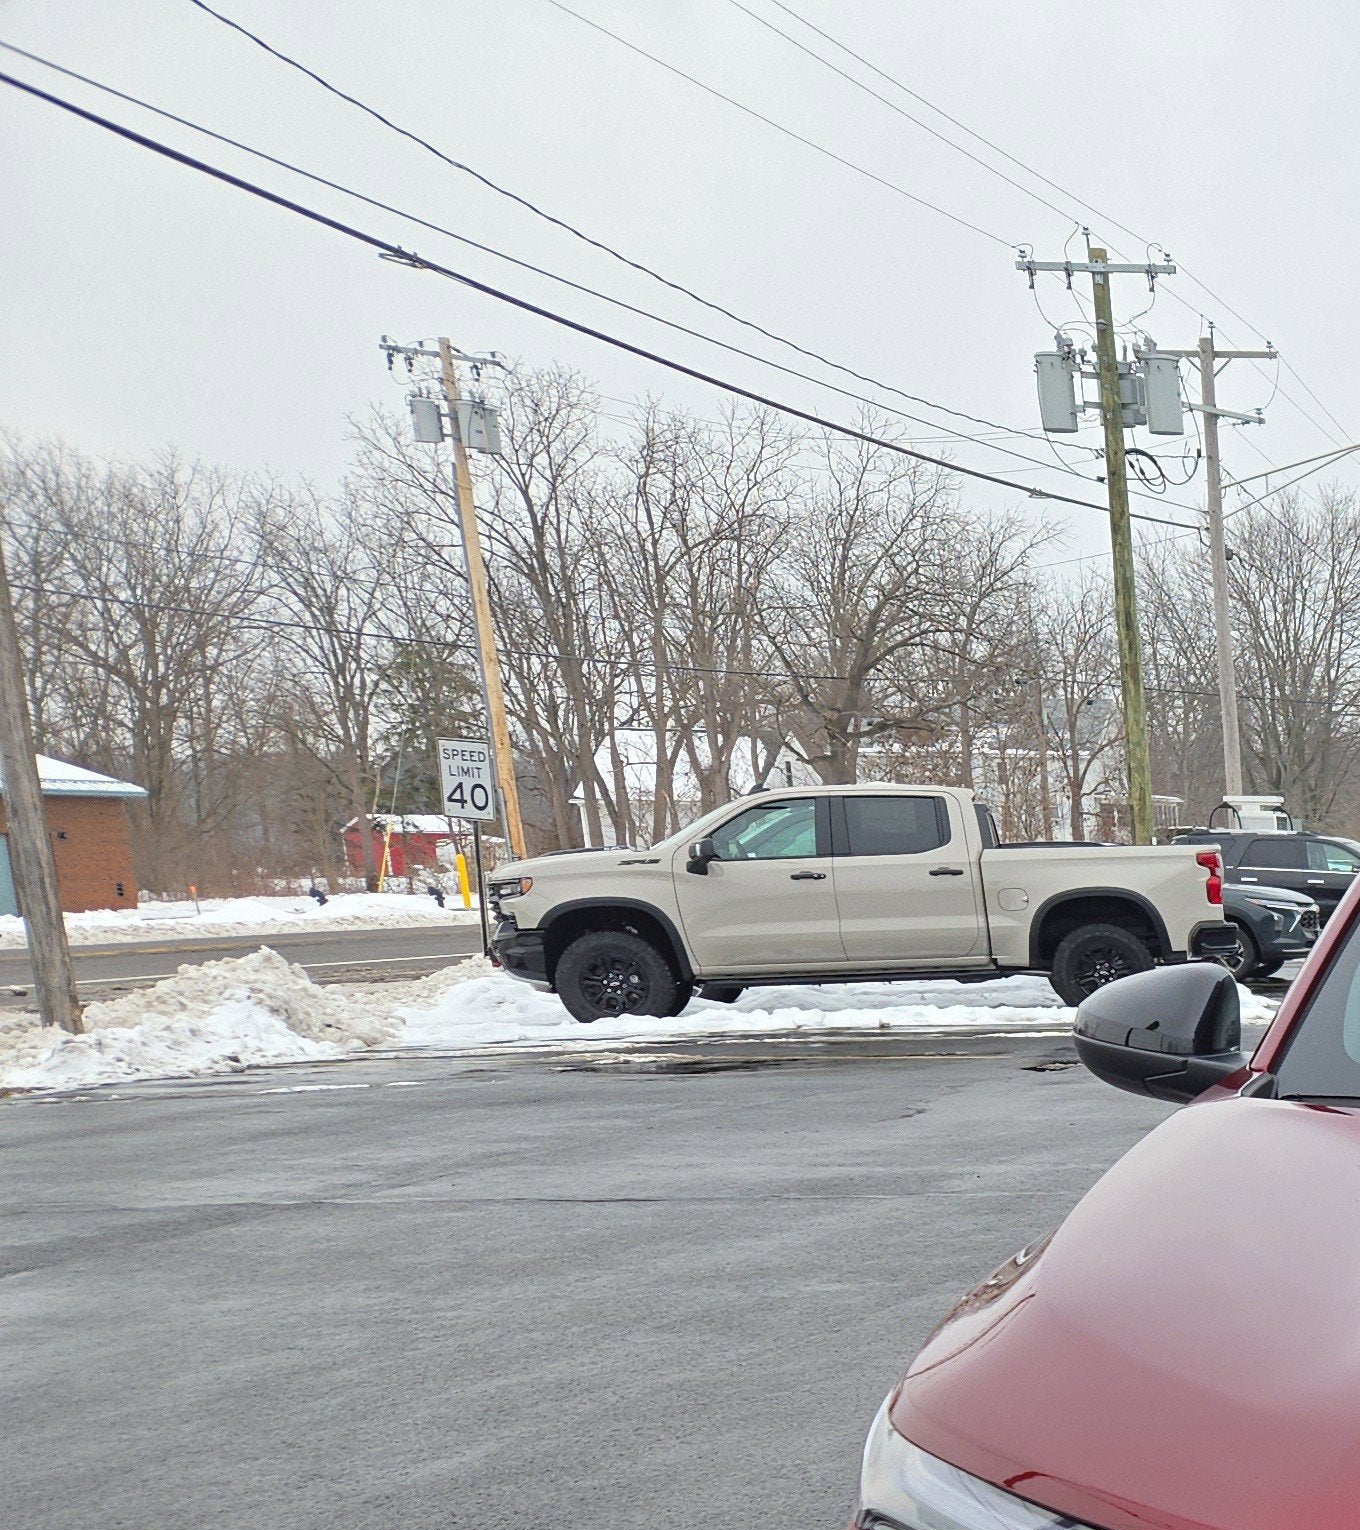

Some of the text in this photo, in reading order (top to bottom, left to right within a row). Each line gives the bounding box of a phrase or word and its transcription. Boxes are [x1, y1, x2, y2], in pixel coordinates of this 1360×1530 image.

[442, 748, 486, 763] SPEED
[448, 764, 482, 779] LIMIT
[446, 781, 489, 811] 40
